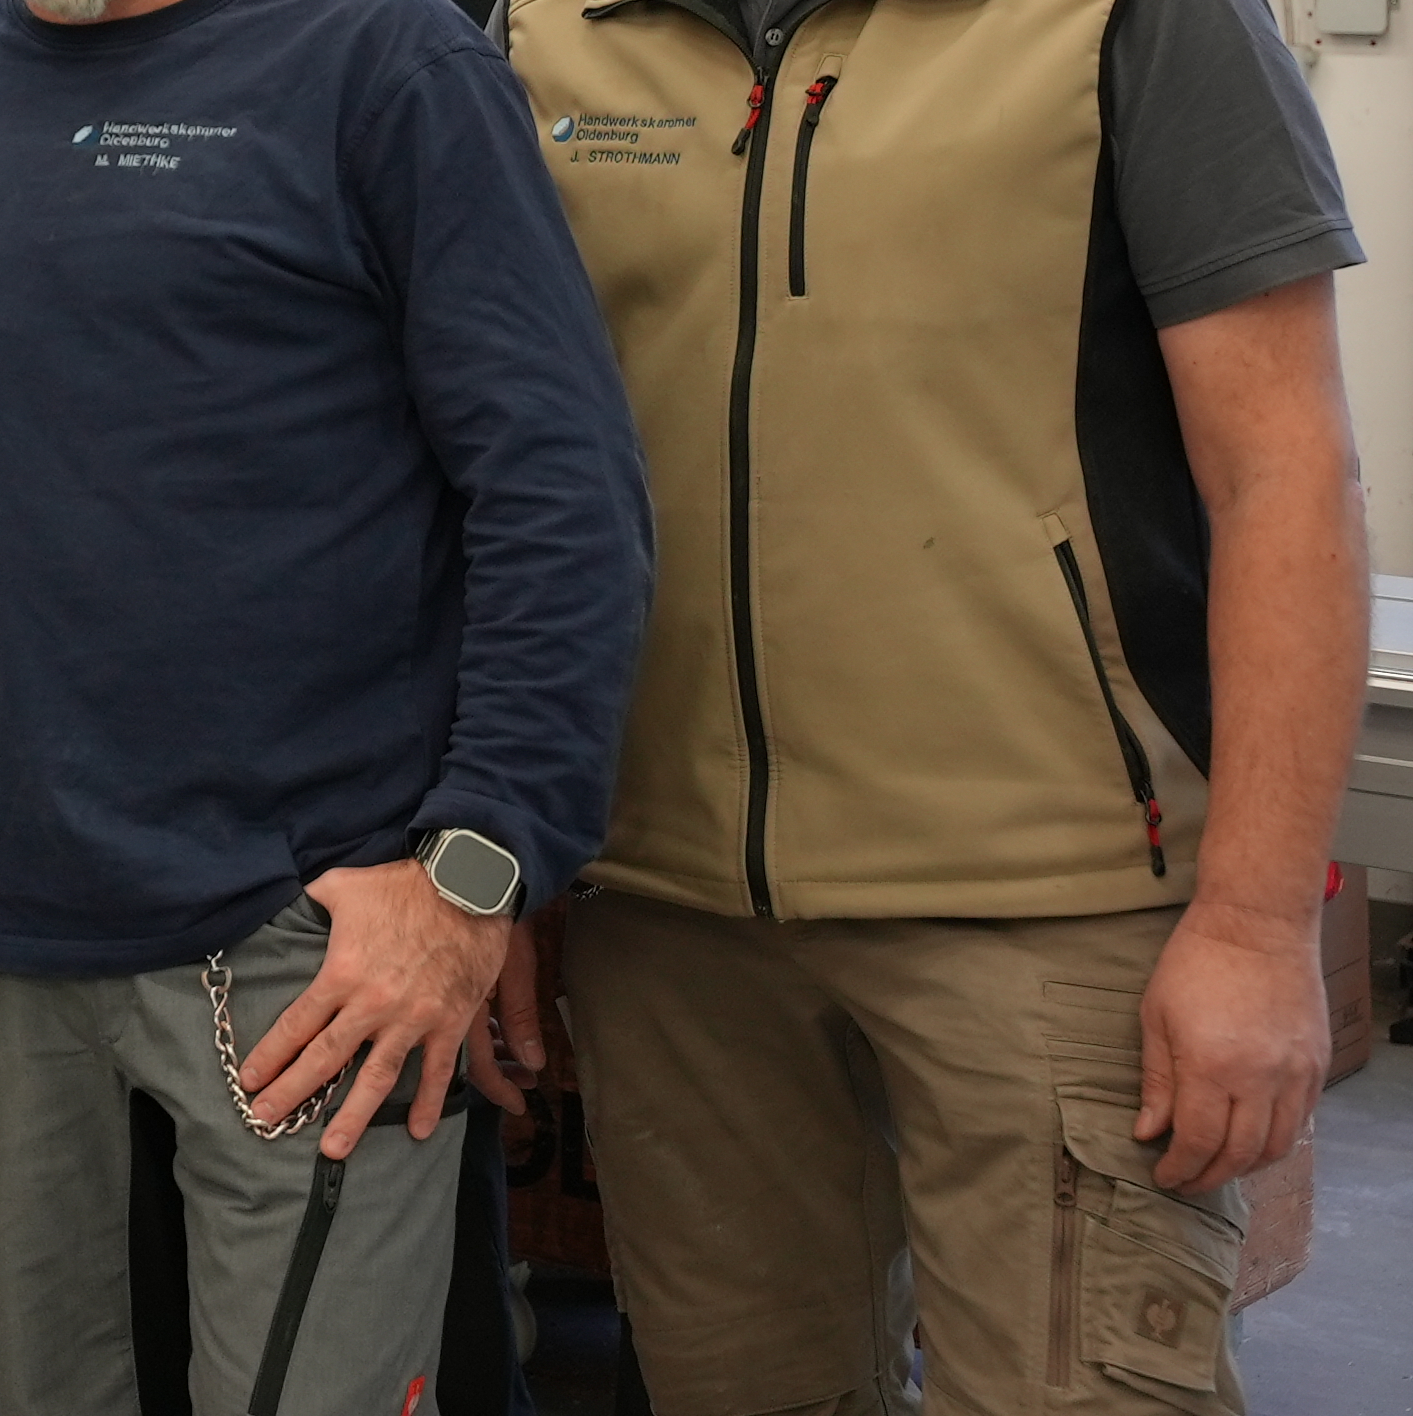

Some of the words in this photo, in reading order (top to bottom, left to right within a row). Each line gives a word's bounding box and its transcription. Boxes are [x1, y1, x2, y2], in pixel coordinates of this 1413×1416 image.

[577, 112, 698, 129] Handwerkskammer
[575, 128, 639, 144] Oldenburg
[116, 152, 182, 170] MIETHKE
[587, 149, 681, 166] STROTHMANN
